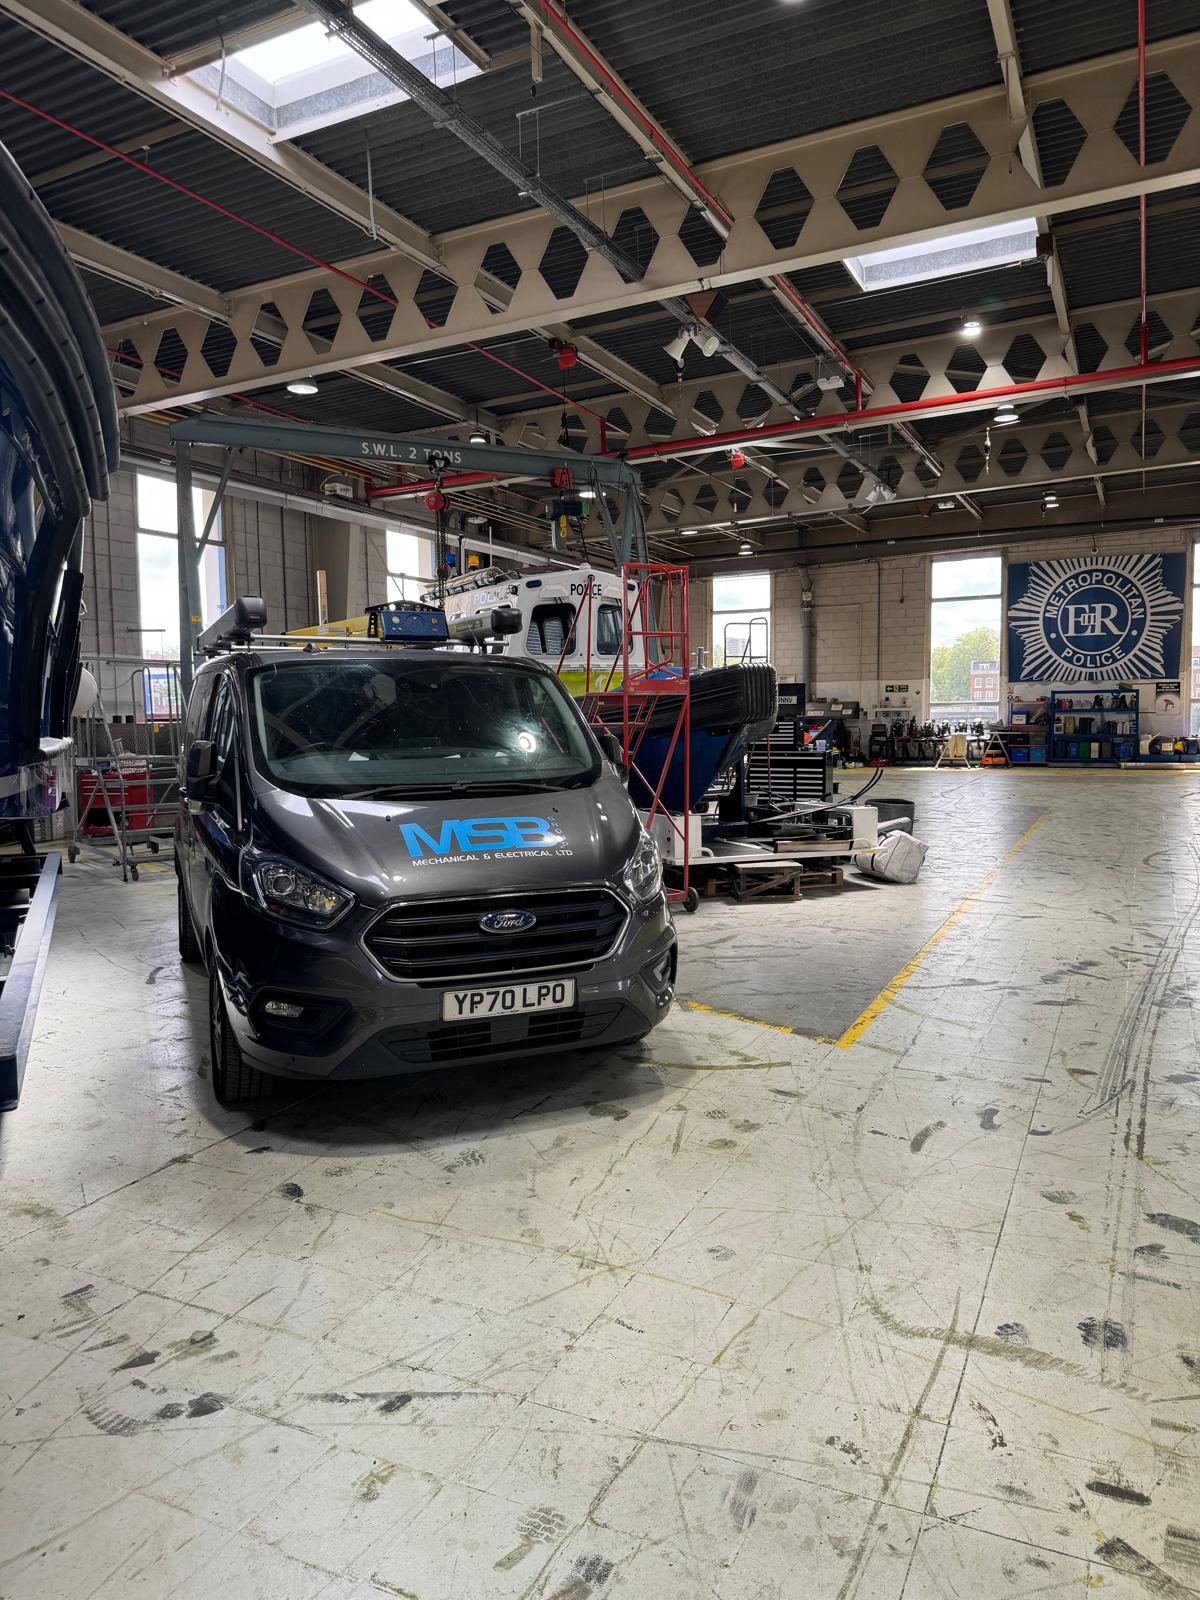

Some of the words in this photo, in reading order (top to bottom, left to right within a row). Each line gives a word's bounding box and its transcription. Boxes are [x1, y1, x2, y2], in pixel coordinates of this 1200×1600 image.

[361, 442, 402, 458] S.W.L.
[408, 447, 417, 459] 2
[423, 448, 463, 464] TONS
[1045, 572, 1145, 619] METROPOLITAN
[1061, 646, 1126, 667] POLICE
[399, 816, 558, 858] MSB
[412, 854, 480, 867] MECHANICAL
[494, 849, 553, 860] ELECTRICAL
[555, 849, 573, 857] LTD
[493, 914, 525, 929] Ford
[454, 988, 516, 1015] YP70
[522, 982, 565, 1008] LPO
